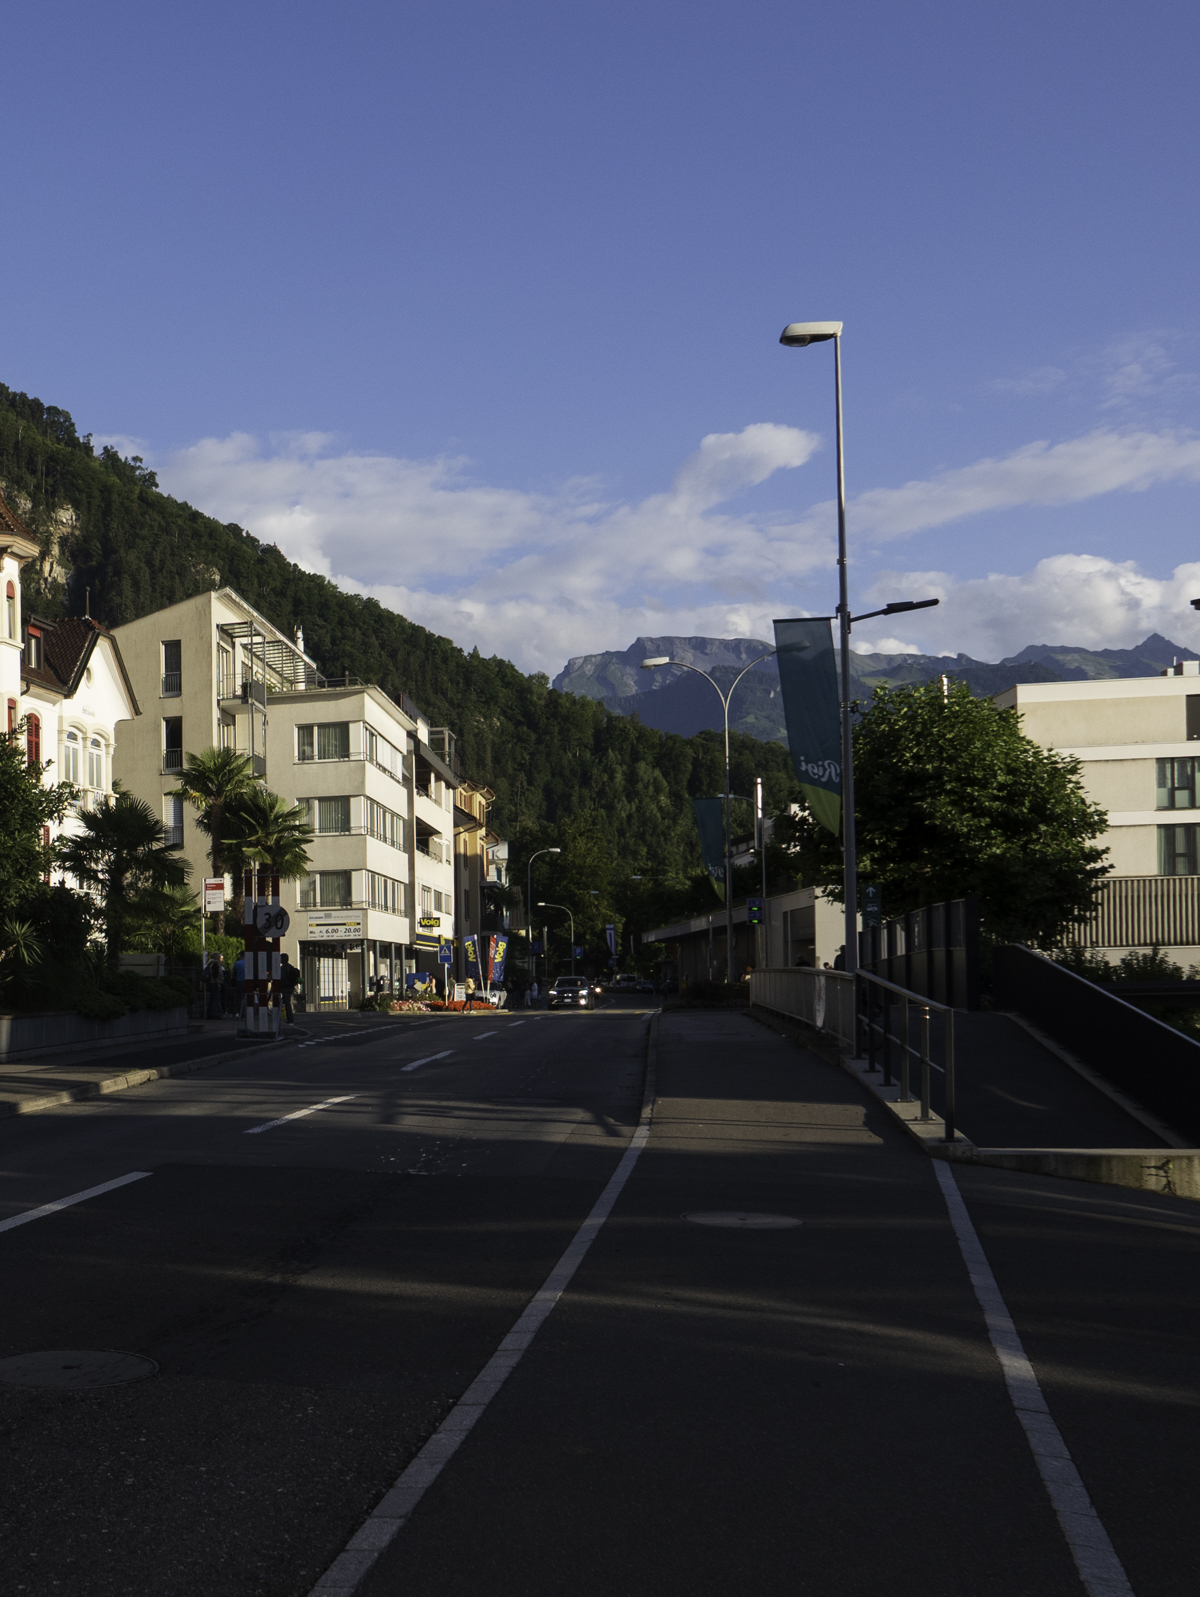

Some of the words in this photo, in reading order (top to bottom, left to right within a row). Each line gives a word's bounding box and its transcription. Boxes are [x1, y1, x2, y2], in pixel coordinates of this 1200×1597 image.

[263, 912, 284, 930] 30
[420, 918, 439, 927] Volg
[494, 941, 507, 963] Volg
